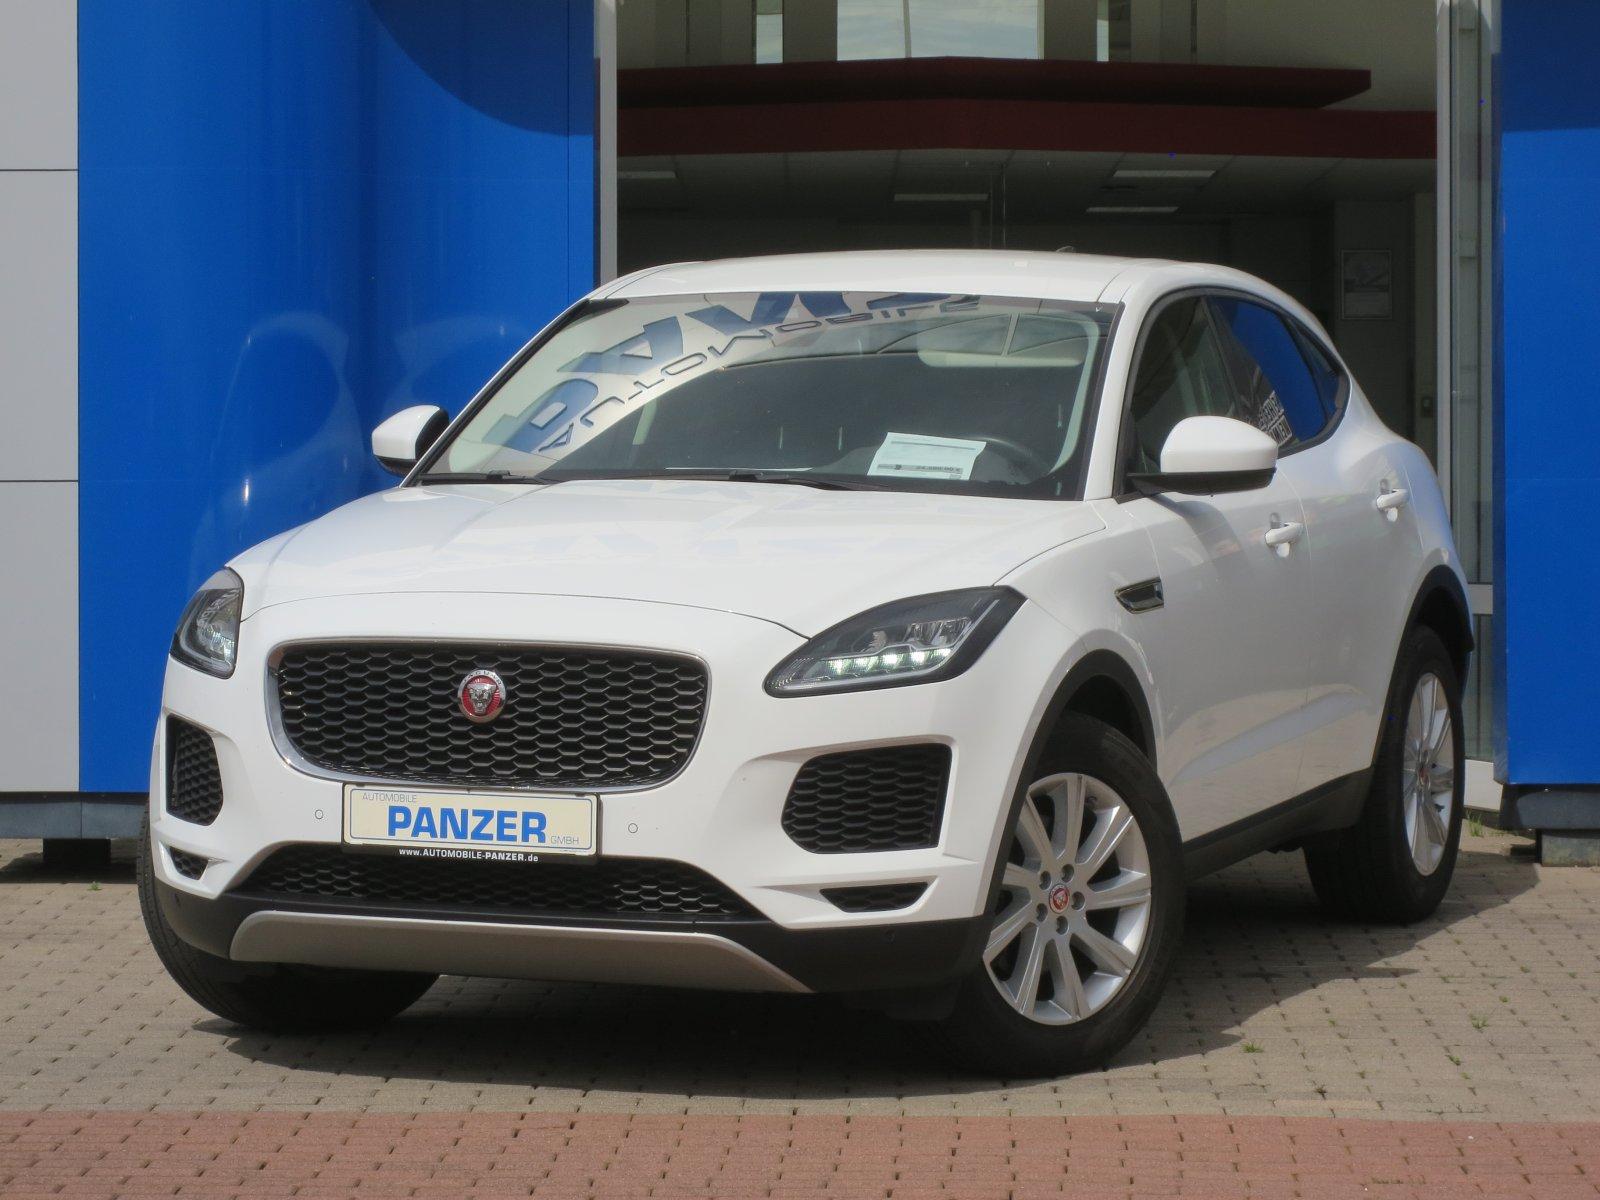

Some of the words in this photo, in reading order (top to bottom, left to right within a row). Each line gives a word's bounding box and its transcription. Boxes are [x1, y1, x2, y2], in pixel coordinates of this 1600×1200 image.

[362, 792, 418, 803] AUTOMOBILE
[387, 805, 547, 844] PANZER
[550, 835, 580, 845] GMBH
[399, 848, 539, 862] www.AUTOMOBILE-PANZER.de
